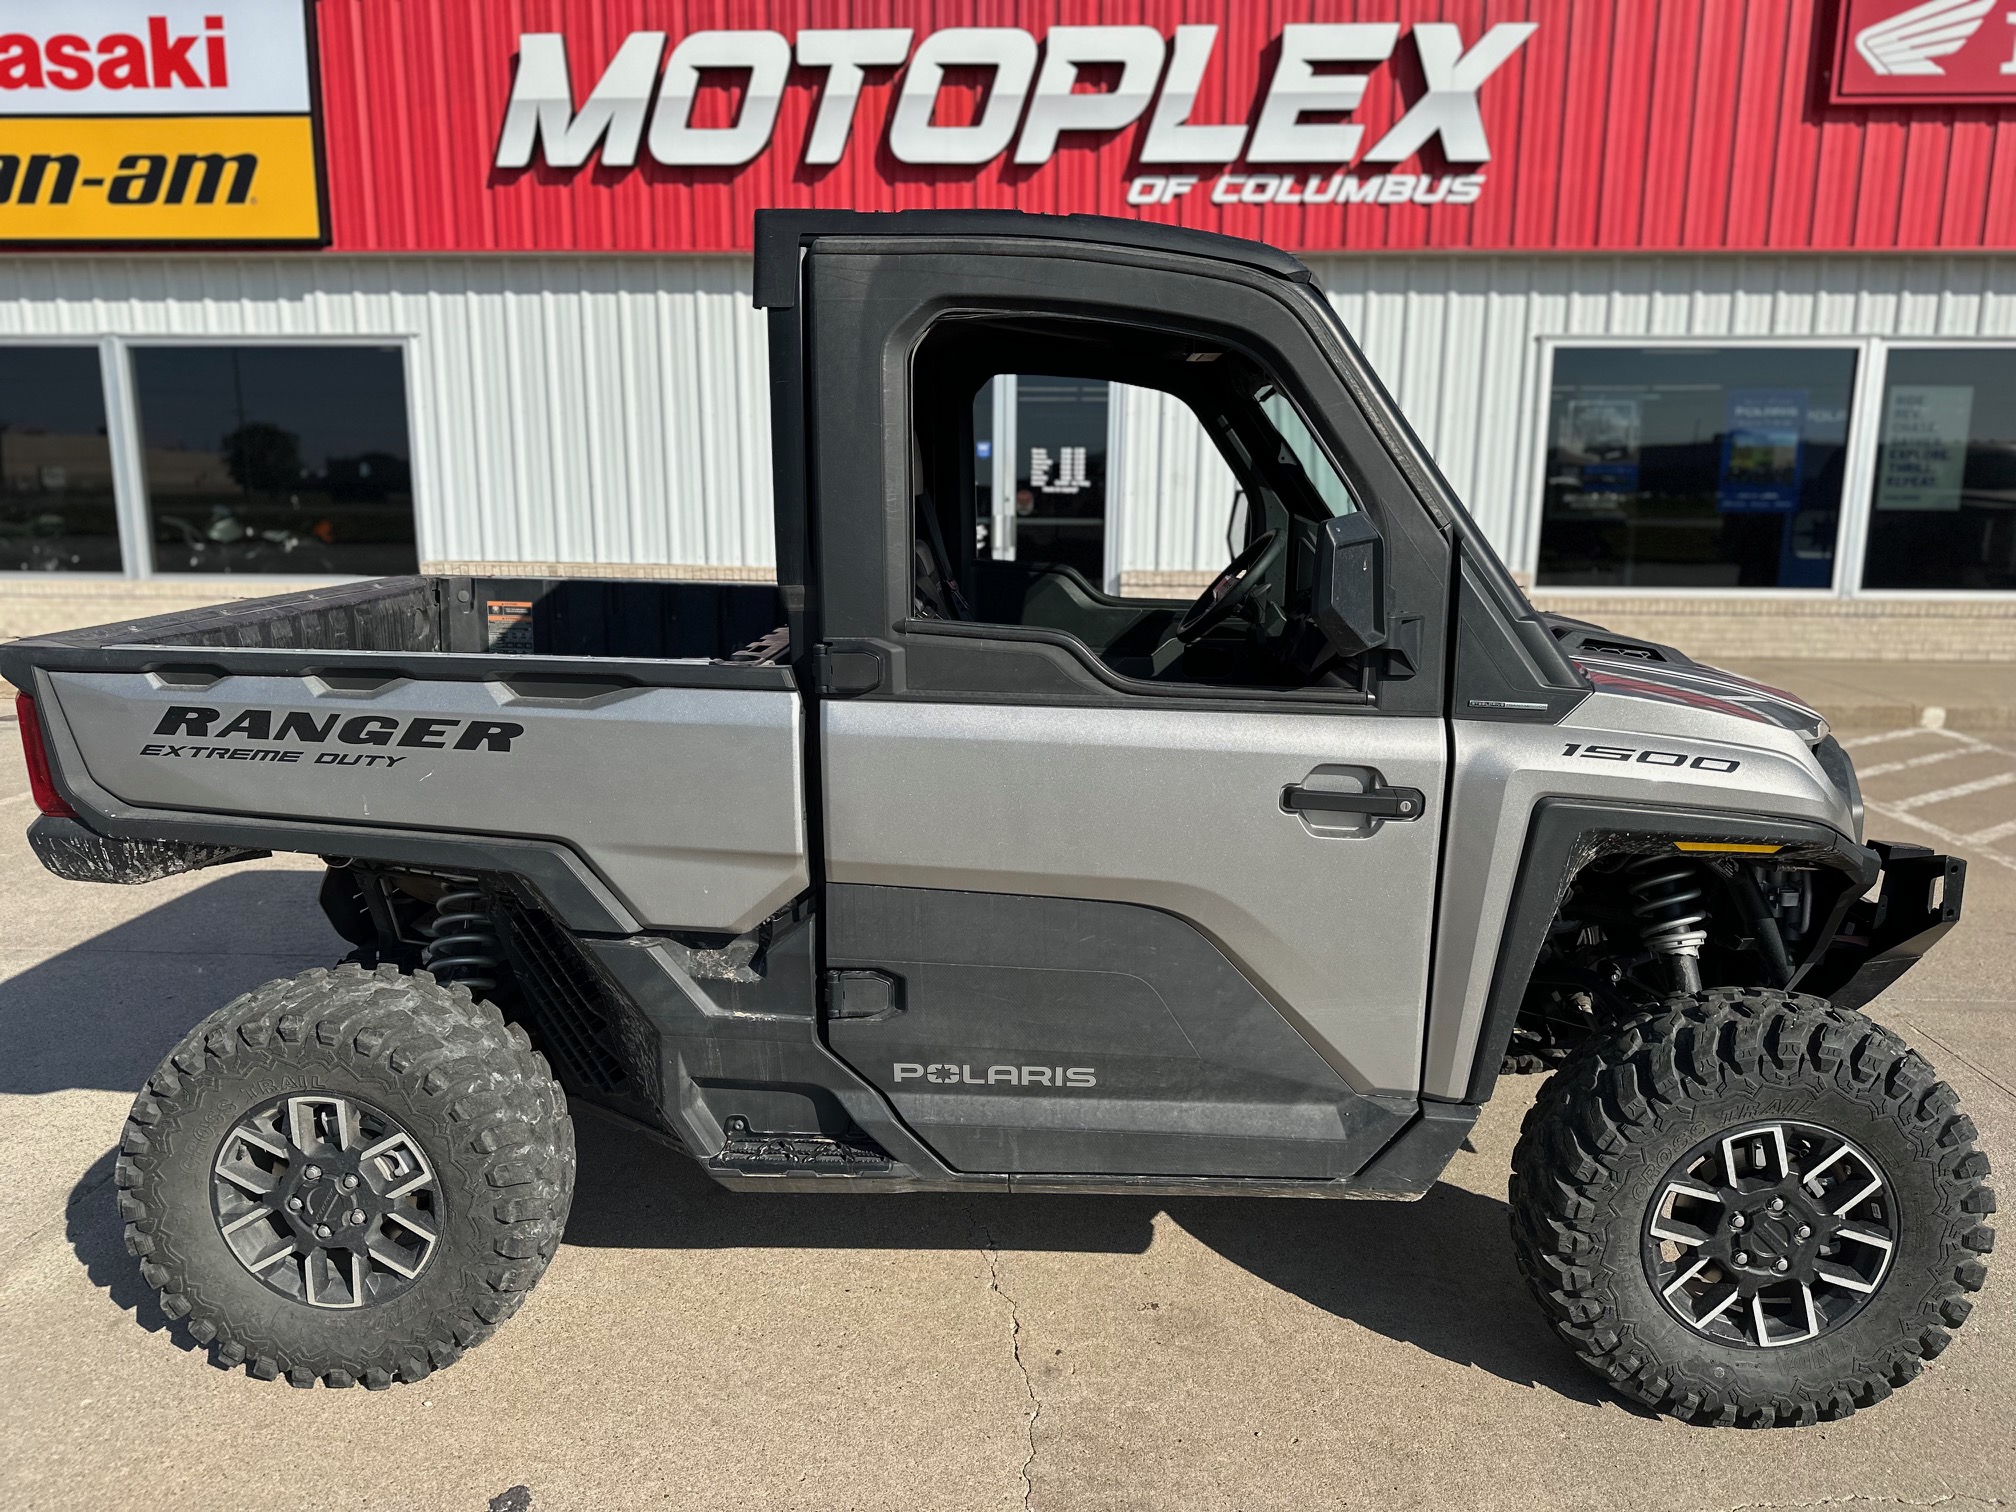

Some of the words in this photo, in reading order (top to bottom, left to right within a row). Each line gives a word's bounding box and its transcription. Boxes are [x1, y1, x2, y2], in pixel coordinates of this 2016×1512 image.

[494, 21, 1540, 169] MOTOPLEX
[1126, 174, 1199, 205] OF
[1210, 174, 1487, 205] COLUMBUS
[153, 705, 525, 753] RANGER
[139, 744, 305, 763] EXTREME
[313, 752, 407, 768] DUTY
[1561, 743, 1741, 773] 1500
[893, 1062, 1097, 1088] POLARIS
[179, 1097, 238, 1174] CROSS
[240, 1075, 327, 1100] TRAIL
[1632, 1120, 1707, 1201] CROSS
[1714, 1098, 1815, 1125] TRAIL
